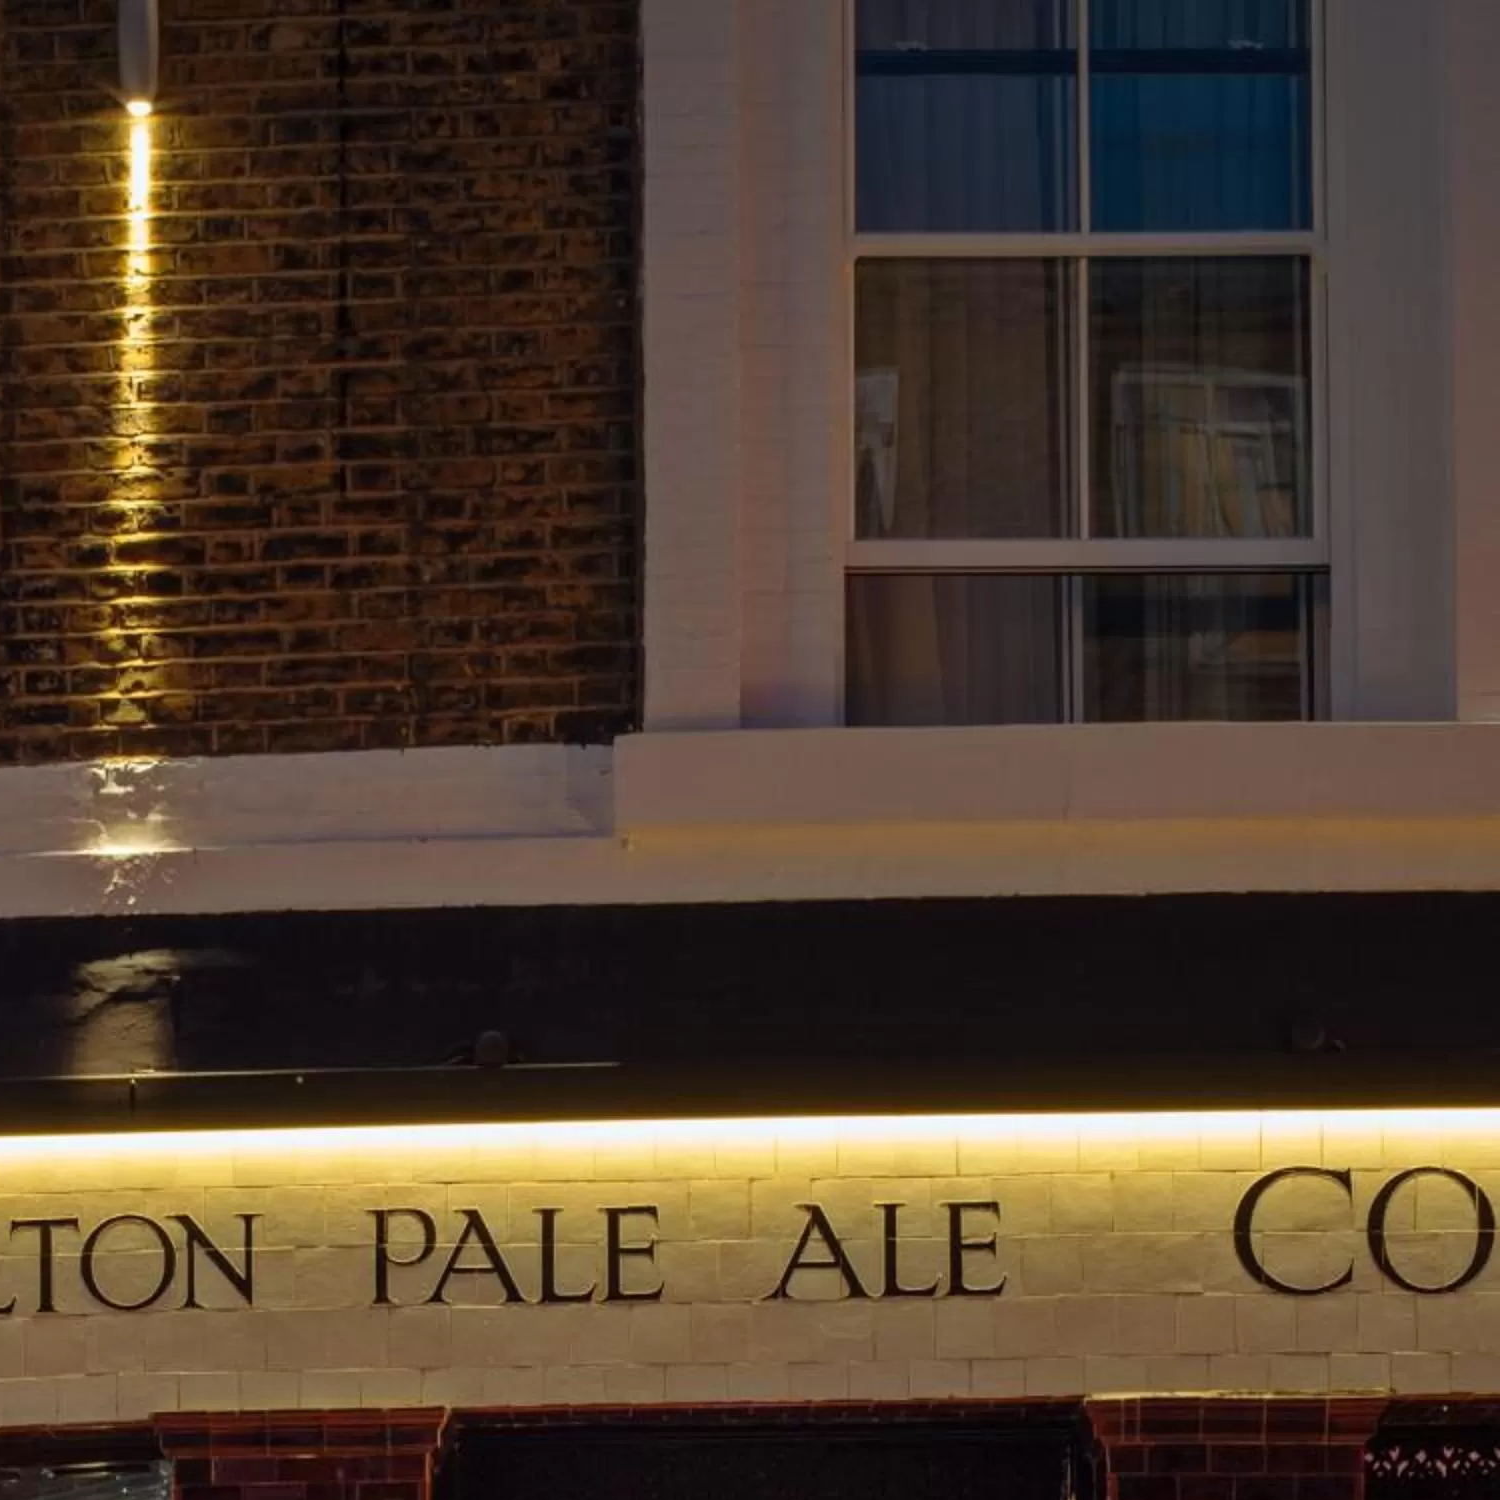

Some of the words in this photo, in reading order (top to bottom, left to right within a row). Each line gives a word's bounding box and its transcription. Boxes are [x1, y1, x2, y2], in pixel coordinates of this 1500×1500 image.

[366, 1205, 664, 1306] PALE
[762, 1200, 1009, 1300] ALE
[1232, 1165, 1498, 1297] CO
